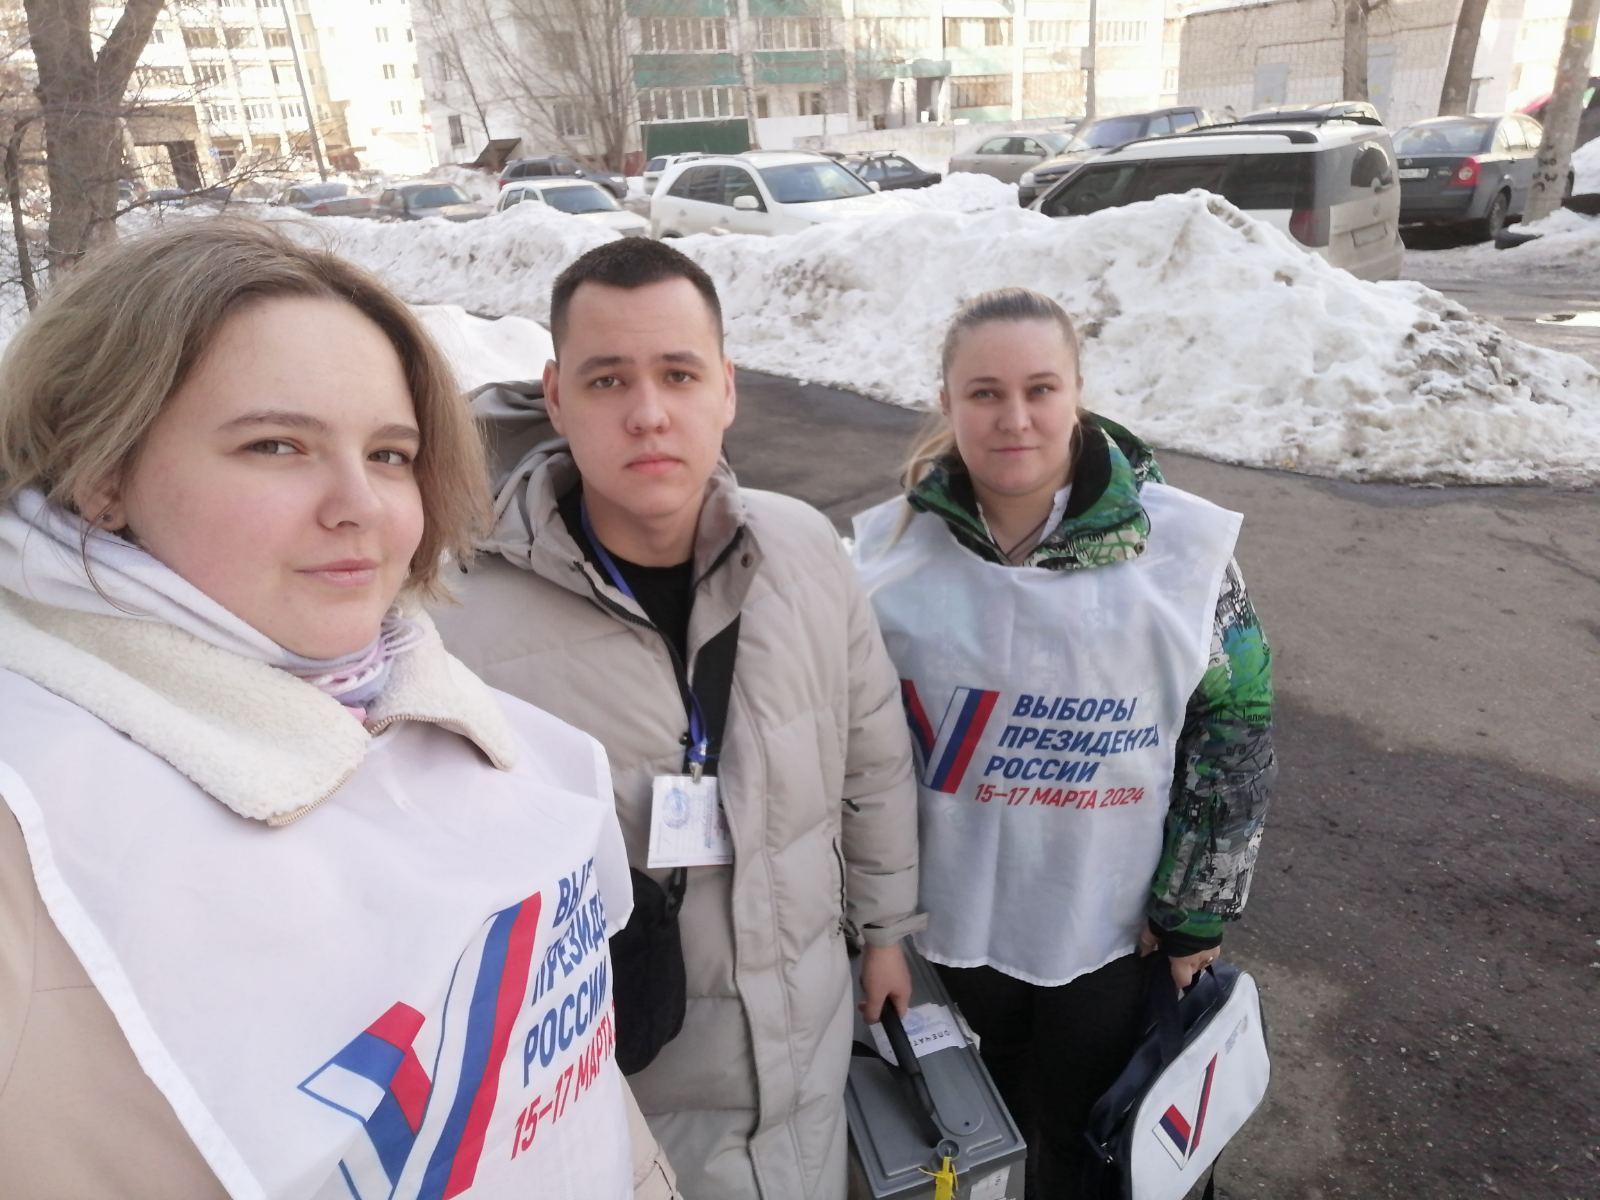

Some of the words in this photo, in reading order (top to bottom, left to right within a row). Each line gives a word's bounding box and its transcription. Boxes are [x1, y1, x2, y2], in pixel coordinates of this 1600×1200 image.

[1012, 694, 1138, 722] ВЫБОРЫ
[998, 724, 1160, 757] ПРЕЗИДЕНТА
[984, 755, 1101, 783] РОССИИ
[1029, 787, 1096, 810] МАРТА
[1100, 786, 1145, 808] 2024
[531, 888, 607, 1006] ПРЕЗИДЕ
[523, 954, 607, 1088] РОССИИ
[574, 1011, 615, 1102] МАРТА
